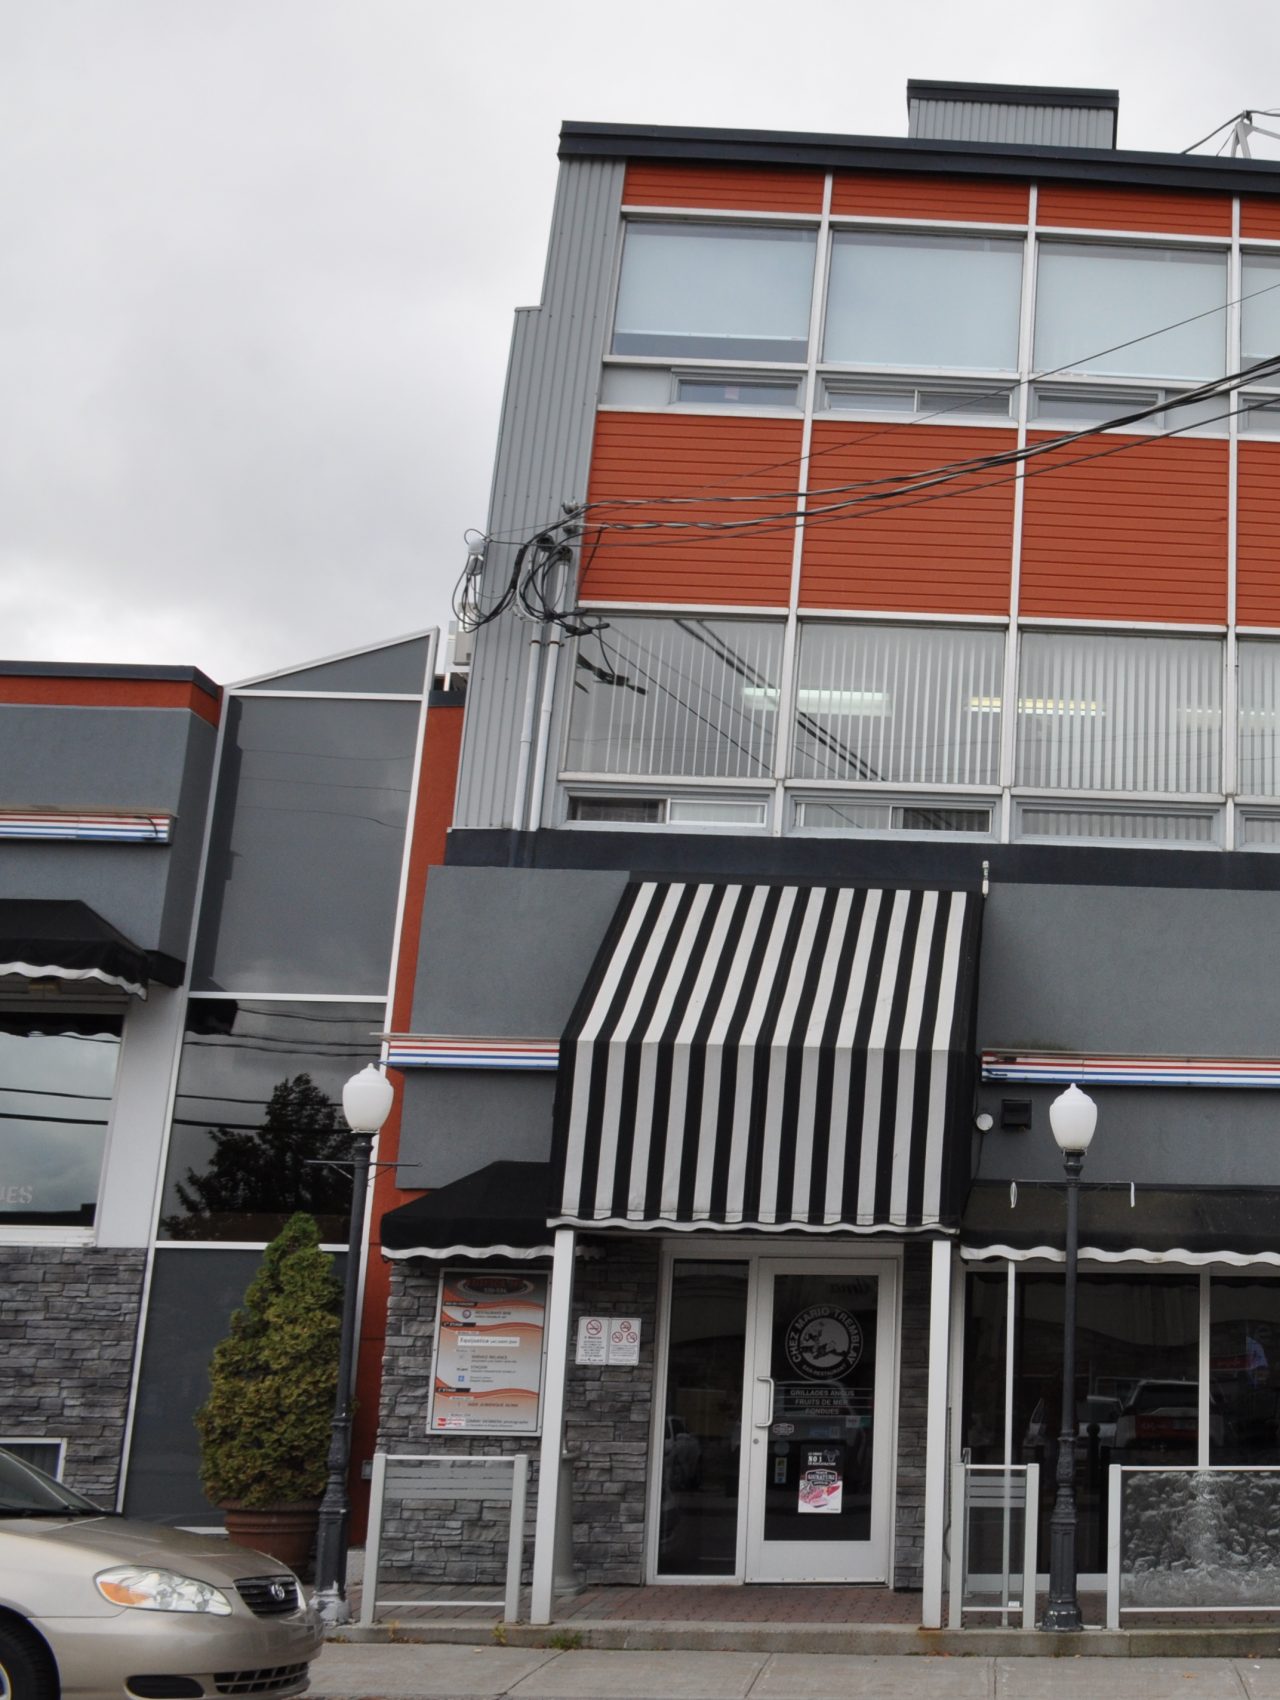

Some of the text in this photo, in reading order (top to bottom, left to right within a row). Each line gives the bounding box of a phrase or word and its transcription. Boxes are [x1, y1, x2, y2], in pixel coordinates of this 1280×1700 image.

[789, 1308, 860, 1365] CHEZ MARIO TREMBLAY
[795, 1398, 820, 1406] FRUITS
